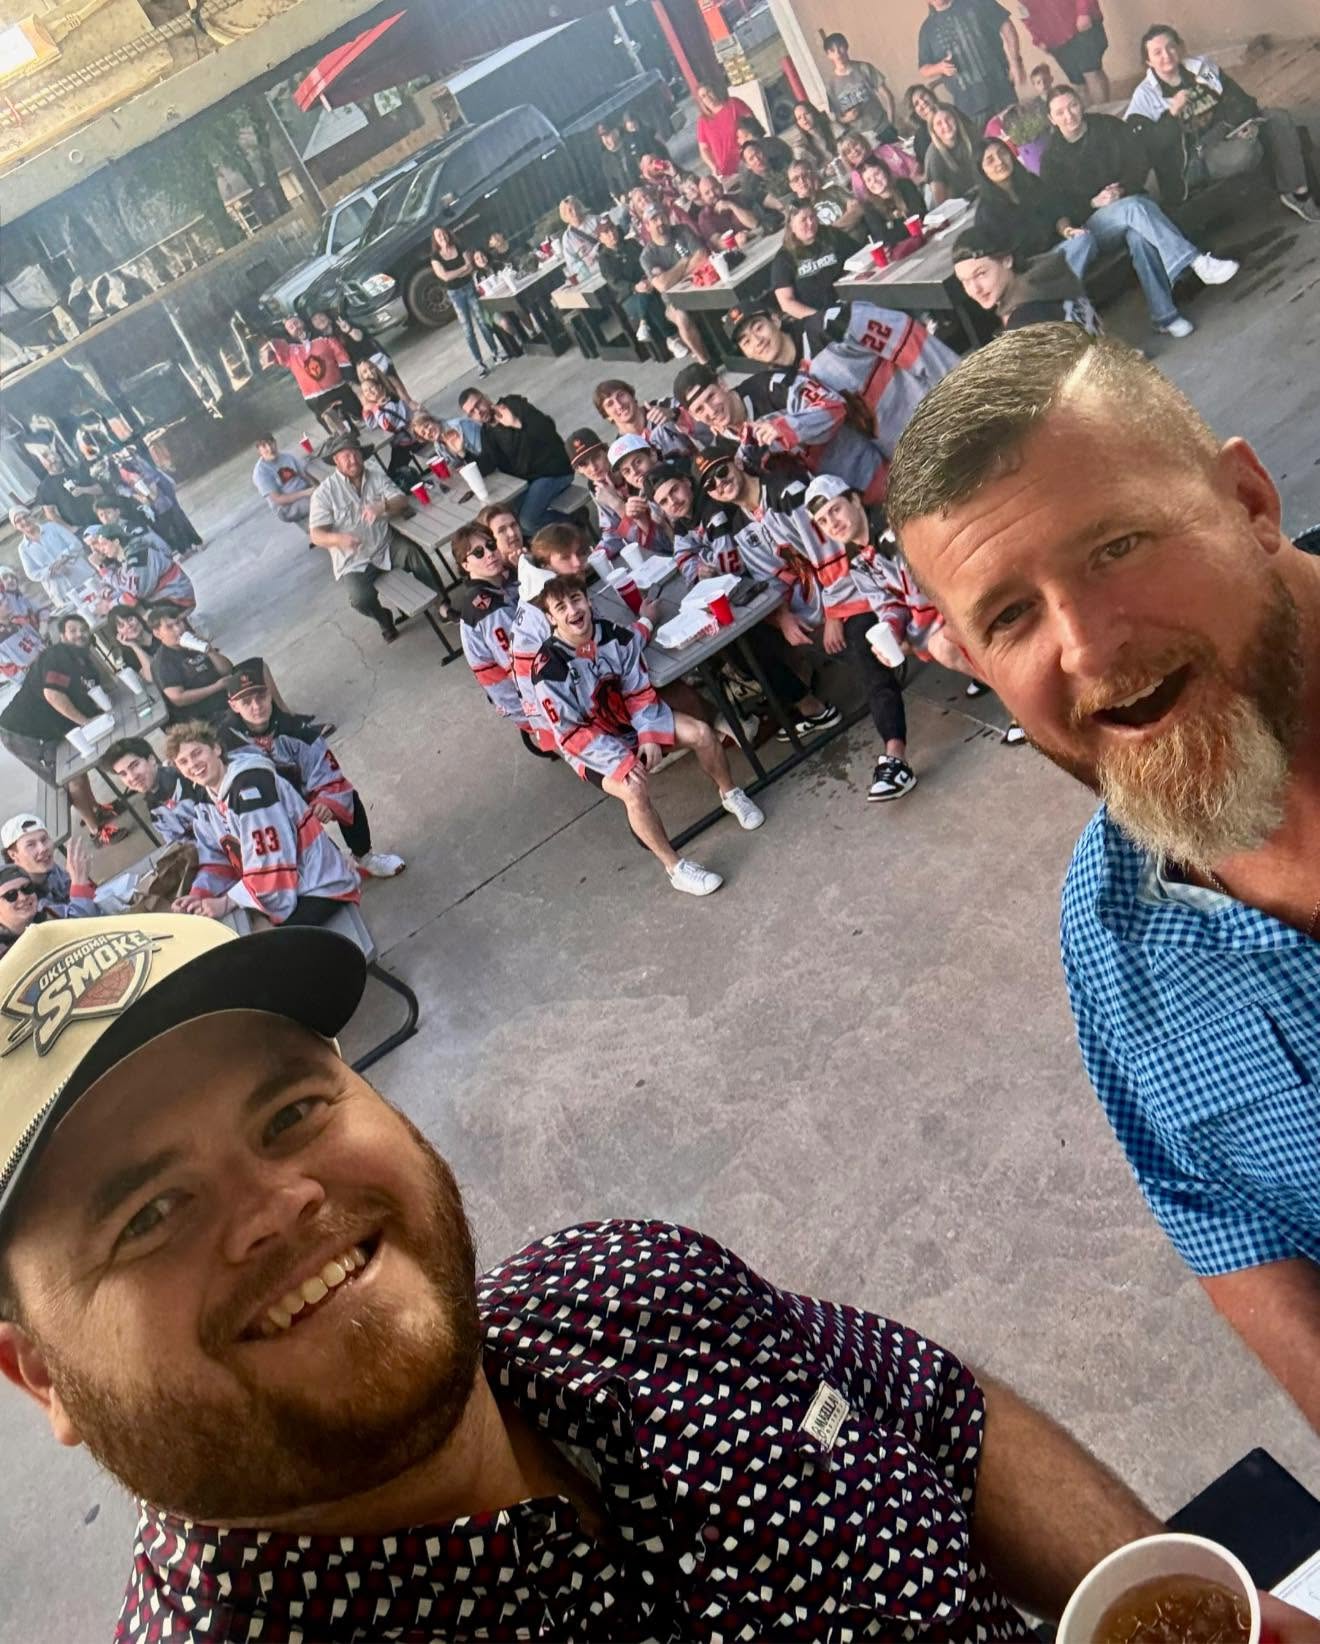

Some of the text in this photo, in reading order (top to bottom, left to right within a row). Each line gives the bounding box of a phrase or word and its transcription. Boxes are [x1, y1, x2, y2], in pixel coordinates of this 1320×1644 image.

[860, 319, 893, 353] 22
[718, 549, 742, 574] 12
[495, 627, 510, 651] 9
[542, 698, 559, 723] 6
[252, 826, 280, 856] 33
[38, 934, 110, 991] OKLAHOMA
[37, 932, 150, 1046] SMOKE
